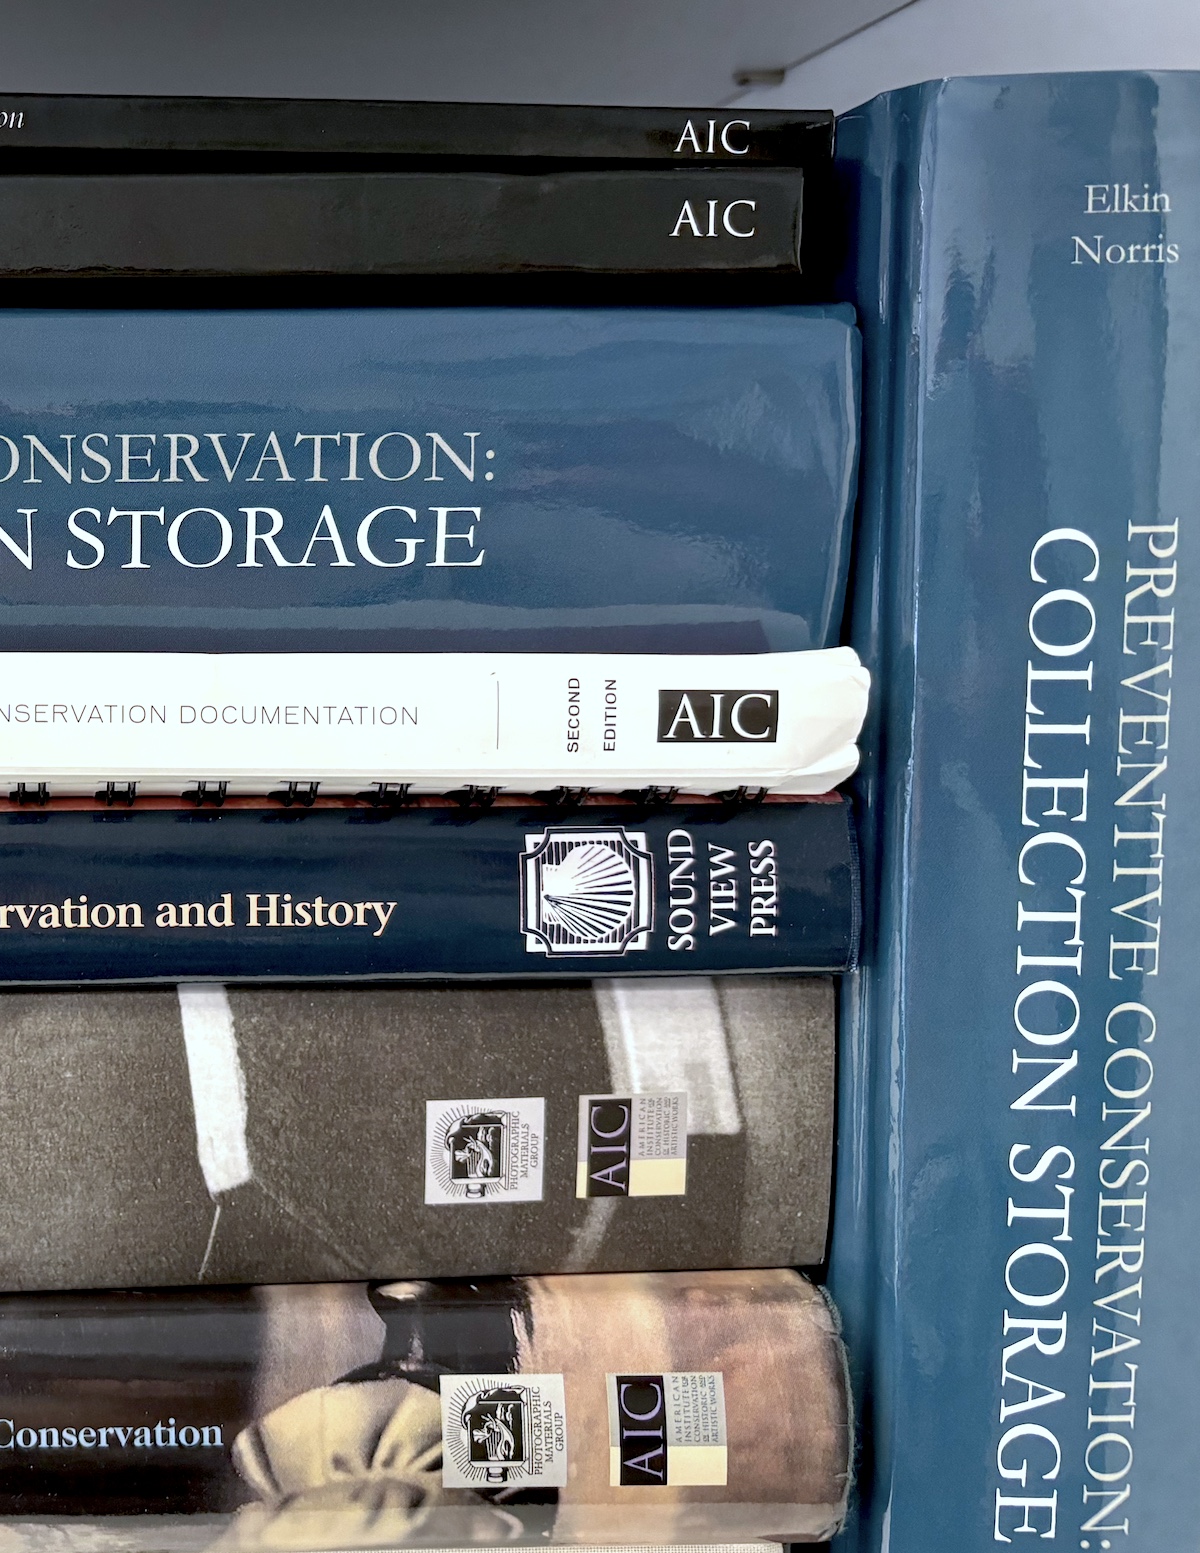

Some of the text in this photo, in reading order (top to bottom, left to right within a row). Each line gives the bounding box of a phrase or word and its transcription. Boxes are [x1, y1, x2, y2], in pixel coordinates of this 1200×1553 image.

[673, 119, 751, 155] AIC
[668, 199, 757, 238] AIC
[1082, 183, 1172, 215] Elkin
[1070, 234, 1180, 265] Norris
[65, 504, 486, 570] STORAGE
[179, 705, 419, 727] DOCUMENTATION
[566, 676, 581, 754] SECOND
[602, 678, 618, 753] EDITION
[662, 692, 773, 741] AIC
[154, 892, 236, 929] and
[245, 892, 397, 937] History
[666, 828, 698, 952] SOUND
[707, 842, 739, 937] VIEW
[748, 839, 780, 938] PRESS
[993, 527, 1100, 1543] COLLECTION STORAGE
[1079, 516, 1179, 1551] PREVENTIVE CONSERVATION:
[510, 1110, 521, 1190] PHOTOGRAPHIC
[520, 1122, 531, 1179] MATERIALS
[530, 1132, 540, 1169] GROUP
[589, 1103, 629, 1193] AIC
[638, 1098, 646, 1157] AMERICAN
[646, 1109, 655, 1156] INSTITUTE
[654, 1097, 662, 1156] CONSERVATION
[532, 1386, 543, 1476] PHOTOGRAPHIC
[544, 1400, 555, 1464] MATERIALS
[555, 1412, 564, 1452] GROUP
[620, 1382, 664, 1482] AIC
[672, 1375, 682, 1443] AMERICAN
[682, 1390, 691, 1442] INSTITUTE
[690, 1375, 700, 1443] CONSERVATION
[700, 1391, 709, 1432] HISTORIC
